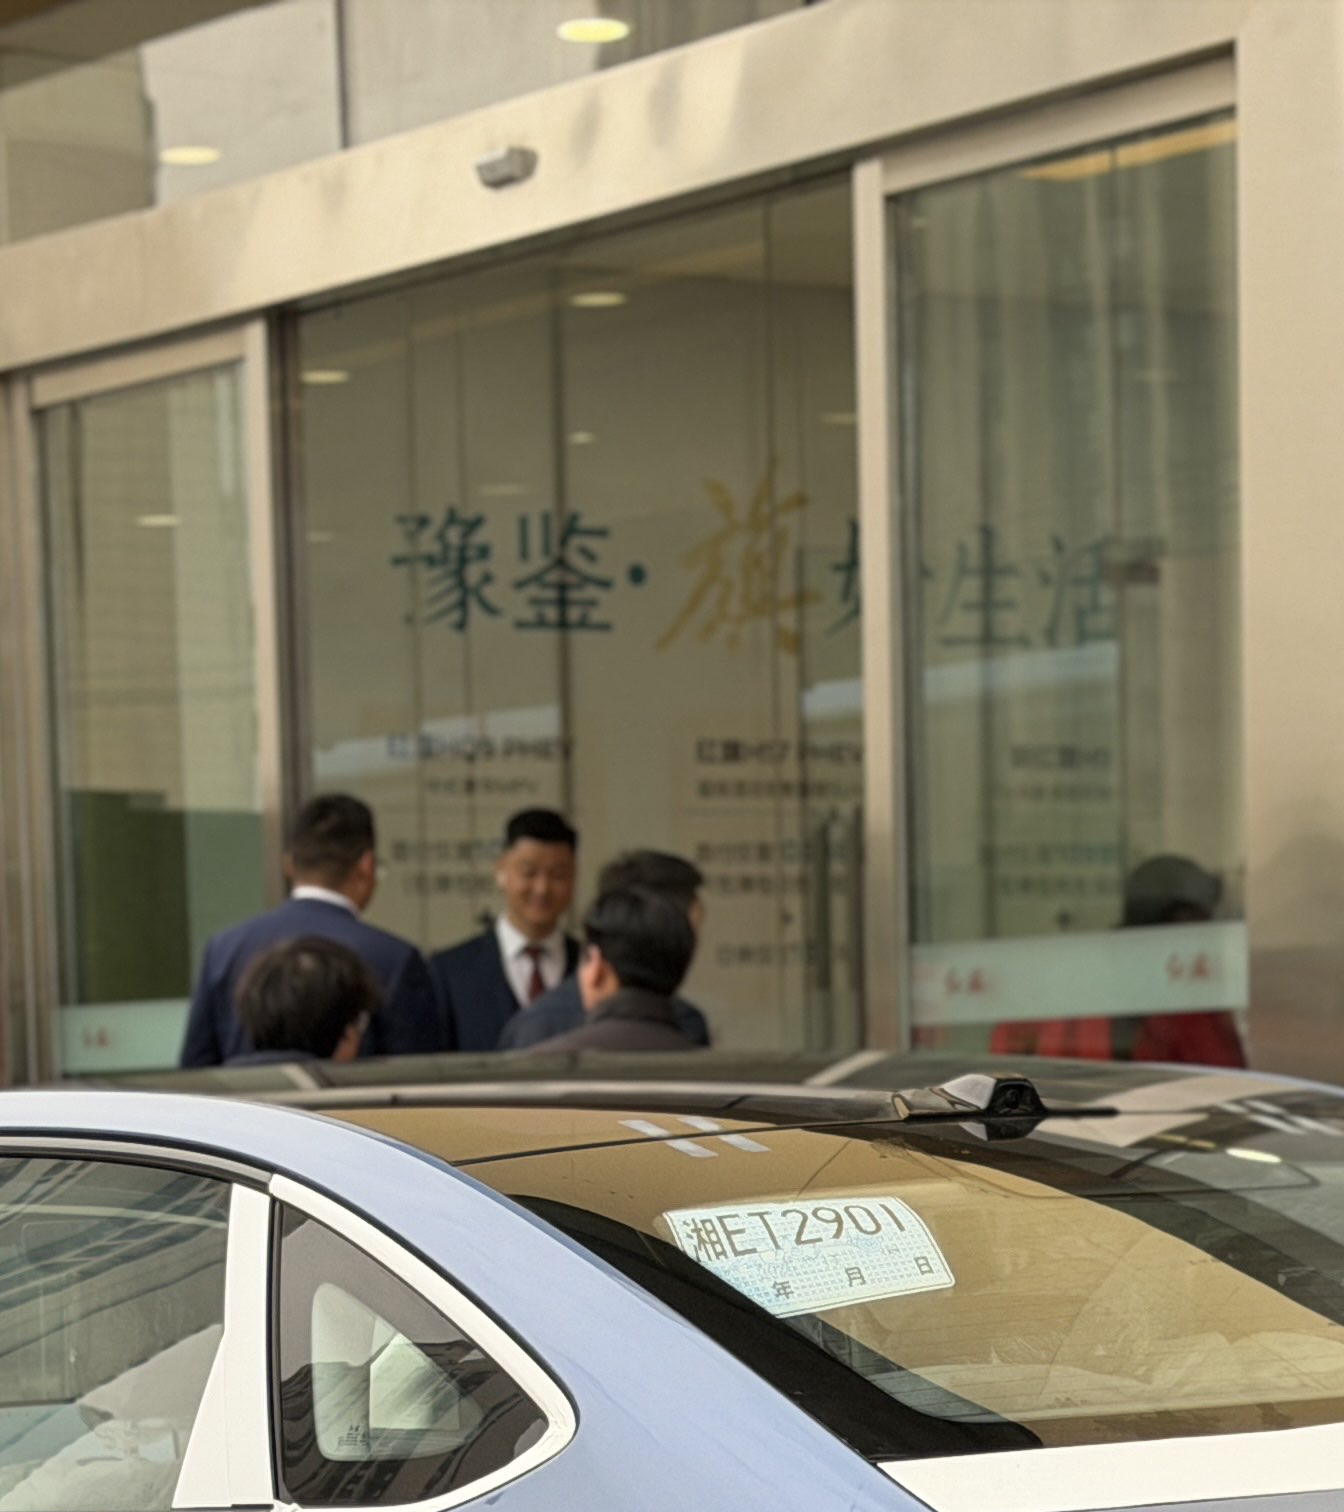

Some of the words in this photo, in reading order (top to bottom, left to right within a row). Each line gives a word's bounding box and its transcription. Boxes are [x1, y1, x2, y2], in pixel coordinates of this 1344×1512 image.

[683, 1203, 905, 1263] 湘ET2901
[772, 1280, 794, 1299] 年
[845, 1266, 866, 1287] 月
[914, 1256, 934, 1275] 日
